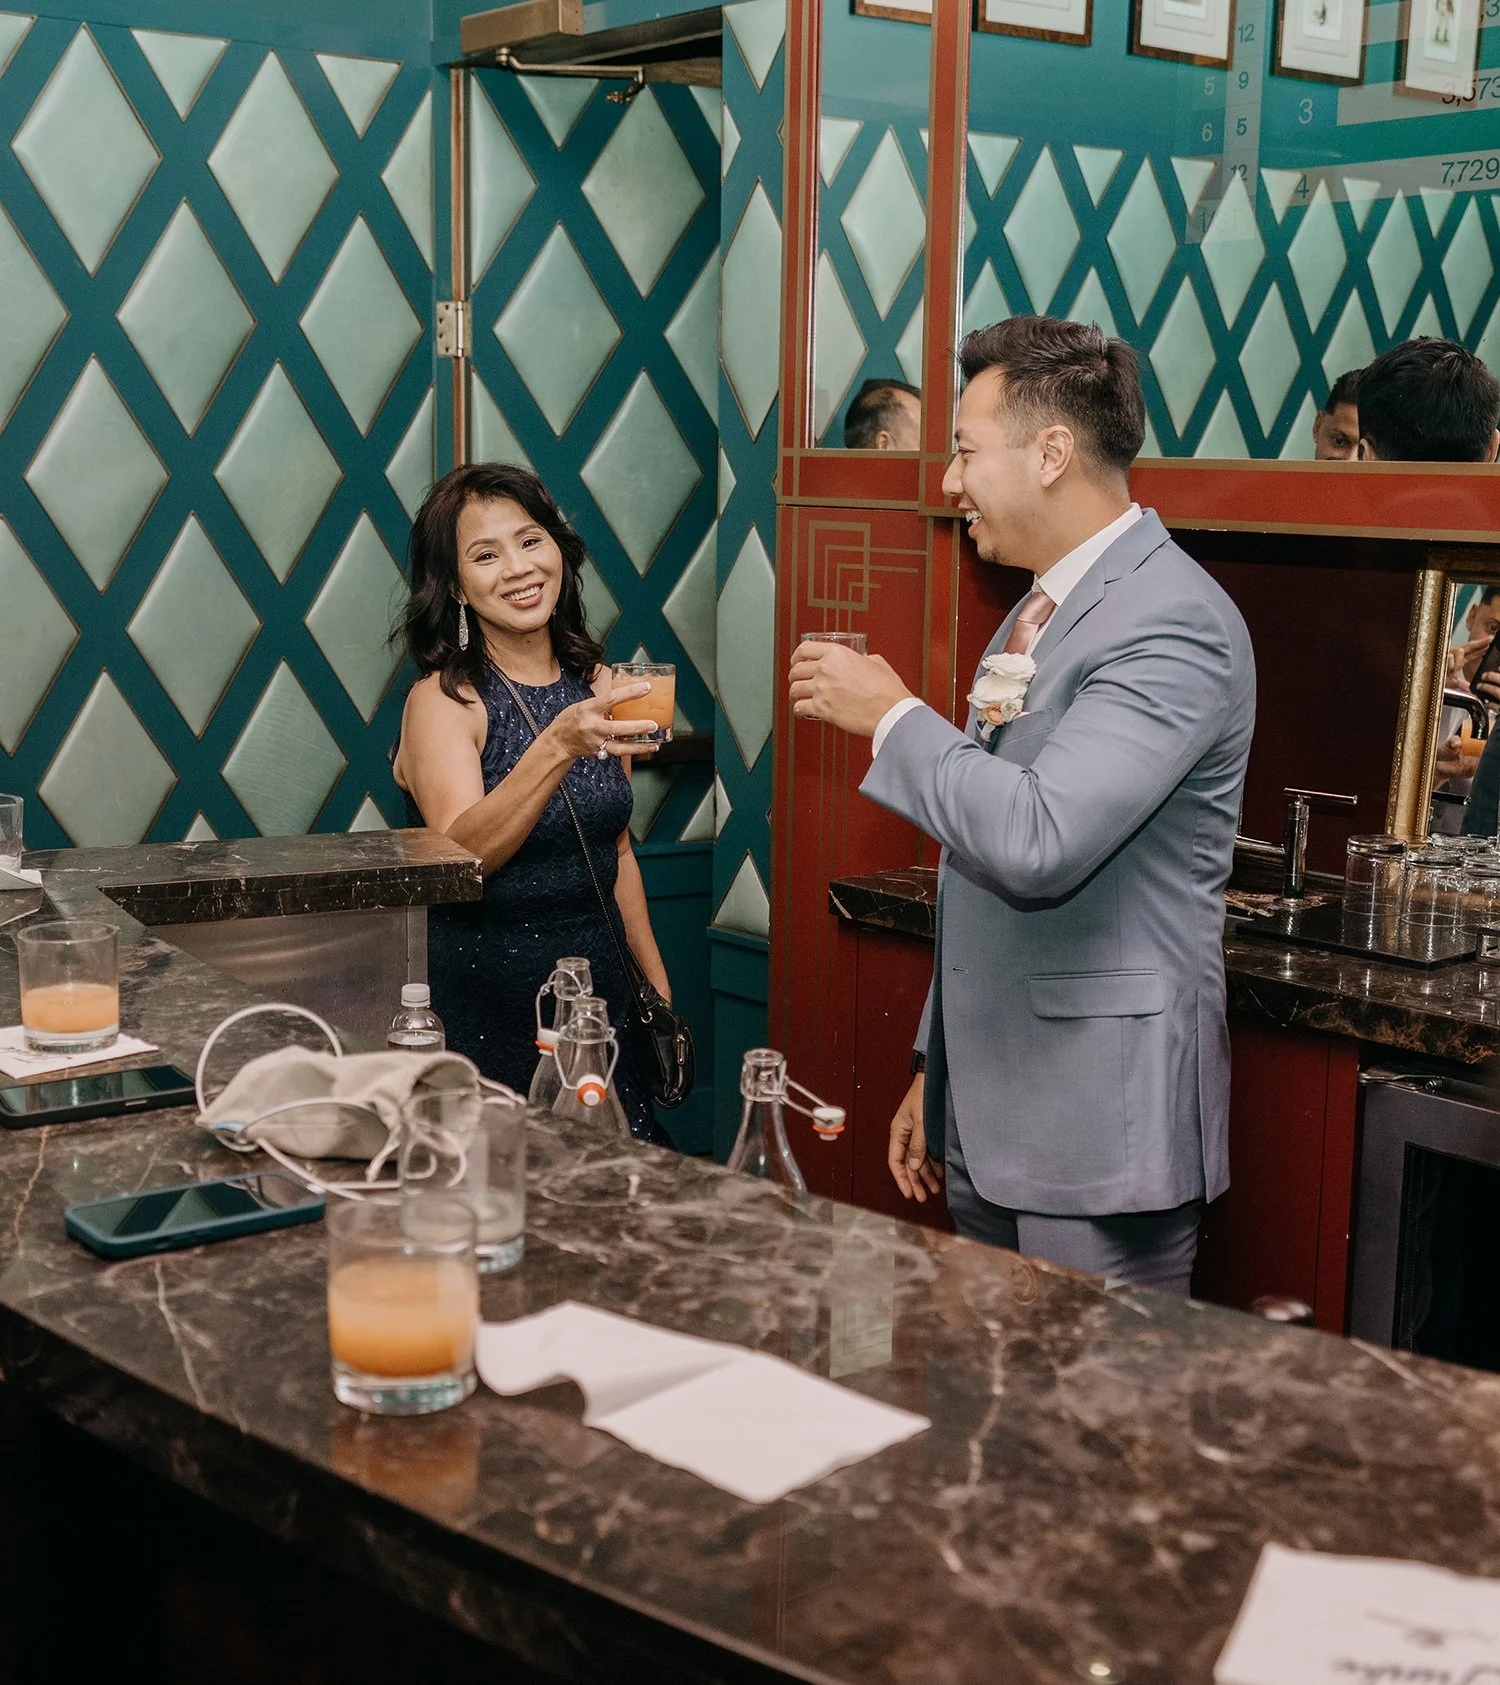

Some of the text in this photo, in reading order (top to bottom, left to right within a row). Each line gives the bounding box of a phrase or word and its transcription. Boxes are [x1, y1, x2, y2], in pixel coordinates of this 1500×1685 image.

[1238, 23, 1255, 43] 12
[1204, 76, 1216, 96] 5
[1238, 71, 1249, 90] 9
[1298, 98, 1313, 124] 3
[1202, 123, 1213, 142] 6
[1236, 118, 1248, 136] 5
[1230, 164, 1248, 181] 12
[1294, 174, 1310, 199] 4
